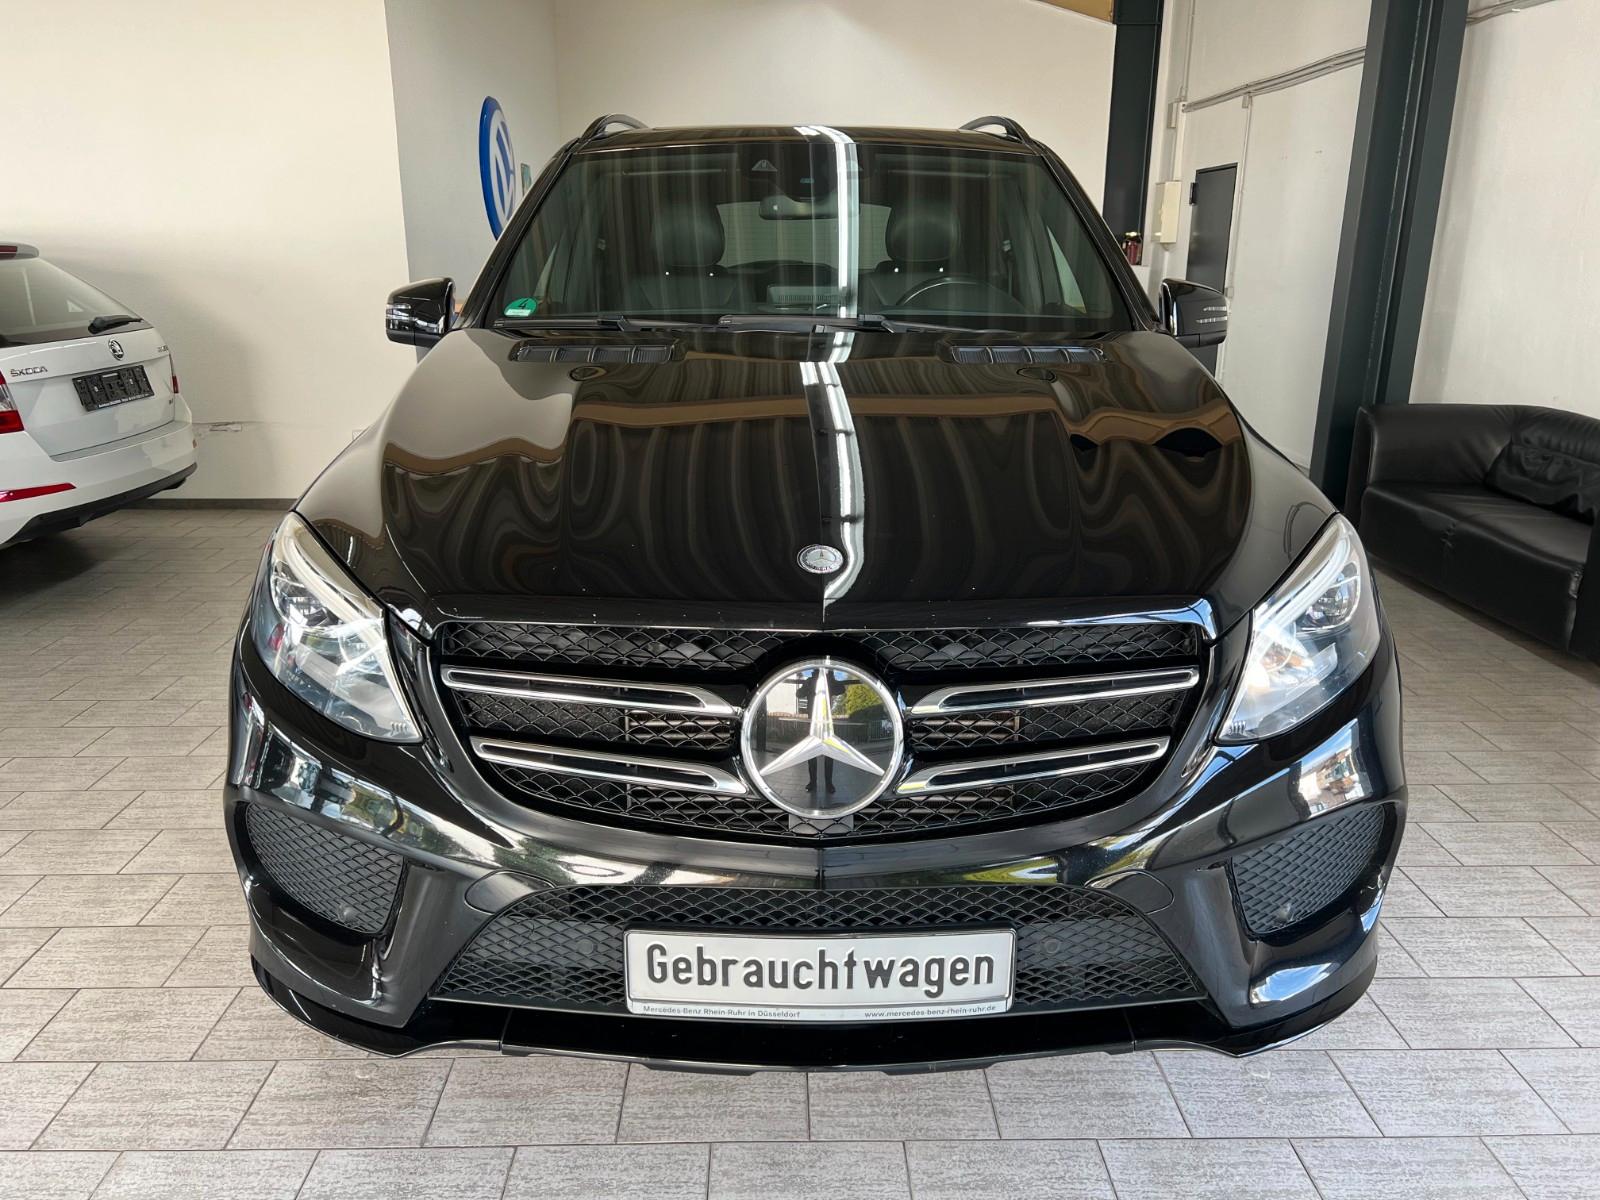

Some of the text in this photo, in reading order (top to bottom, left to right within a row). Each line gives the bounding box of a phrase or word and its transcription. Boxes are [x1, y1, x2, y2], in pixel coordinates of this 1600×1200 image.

[518, 299, 528, 310] 4
[646, 943, 994, 999] Gebrauchtwagen
[757, 1010, 801, 1018] Düsseldorf
[864, 1005, 996, 1018] www.mercedes-benz-rhein-ruhr.de
